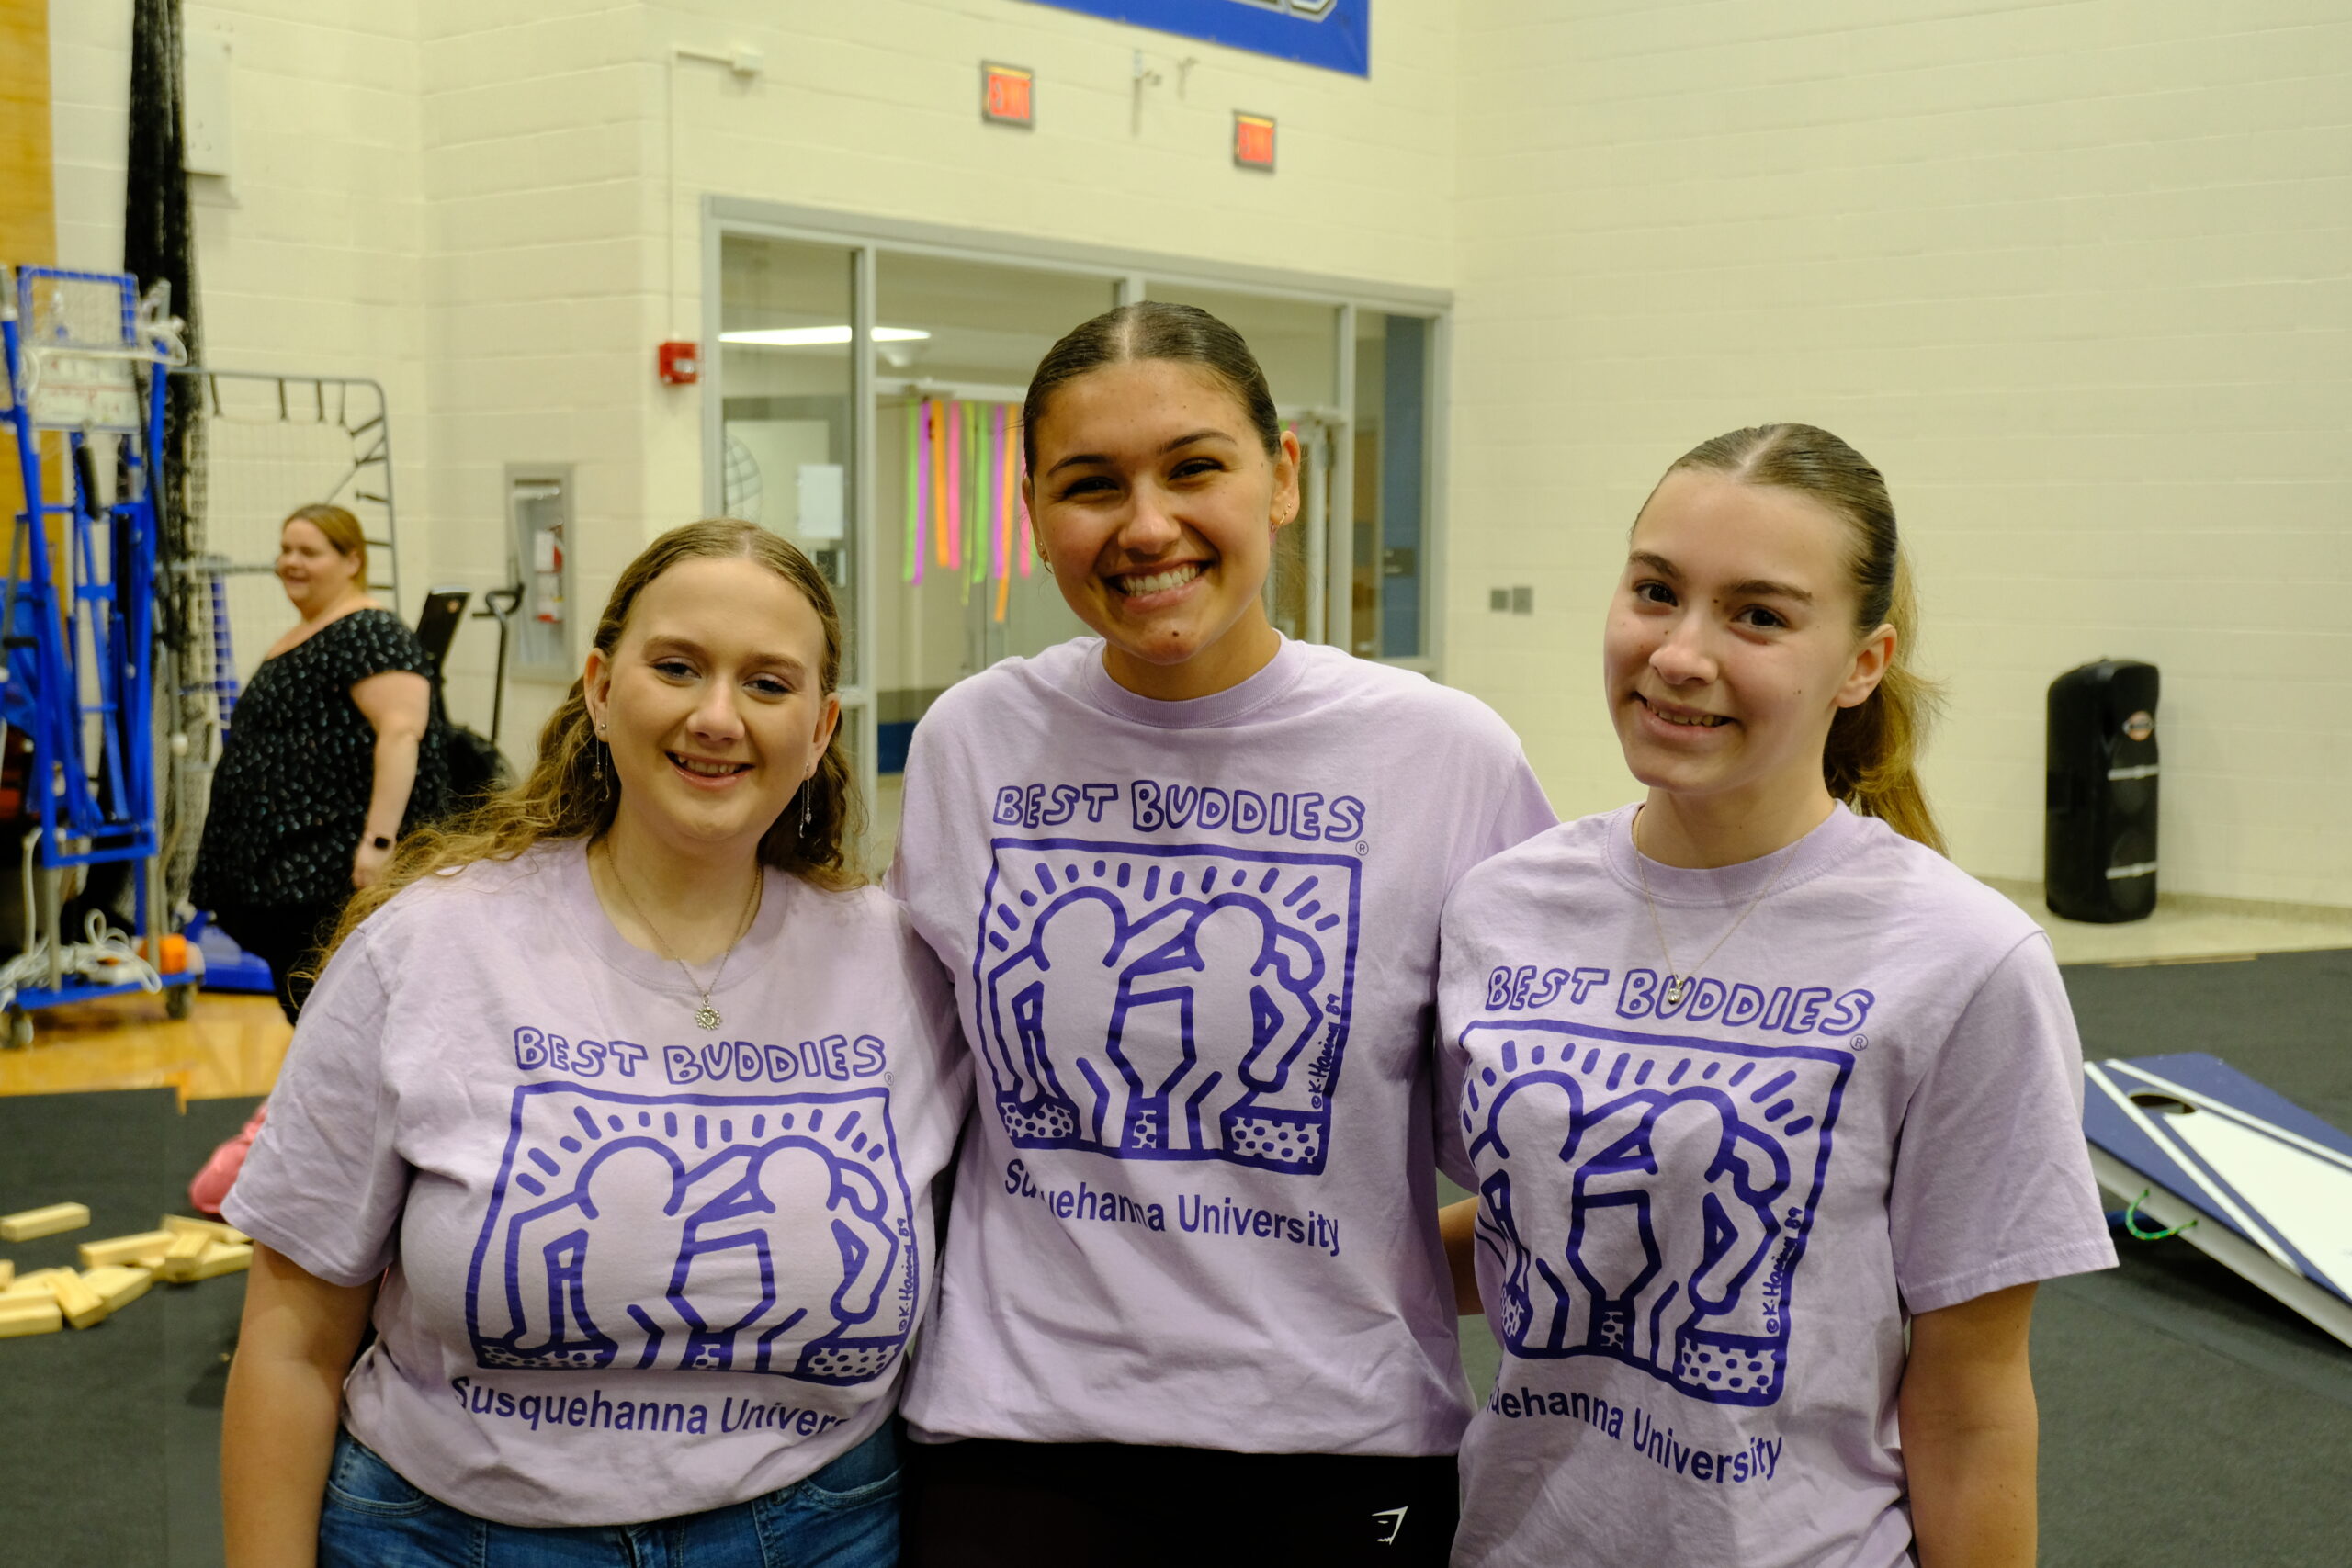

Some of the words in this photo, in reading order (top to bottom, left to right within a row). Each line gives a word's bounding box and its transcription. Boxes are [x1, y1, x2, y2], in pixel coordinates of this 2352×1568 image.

[993, 783, 1119, 829] BEST
[1131, 779, 1367, 843] BUDDIES
[1485, 965, 1610, 1011] BEST
[1615, 968, 1875, 1037] BUDDIES
[514, 1026, 649, 1077] BEST
[663, 1034, 887, 1085] BUDDIES
[1178, 1194, 1340, 1258] University
[451, 1376, 707, 1435] Susquehanna
[1633, 1407, 1783, 1484] University
